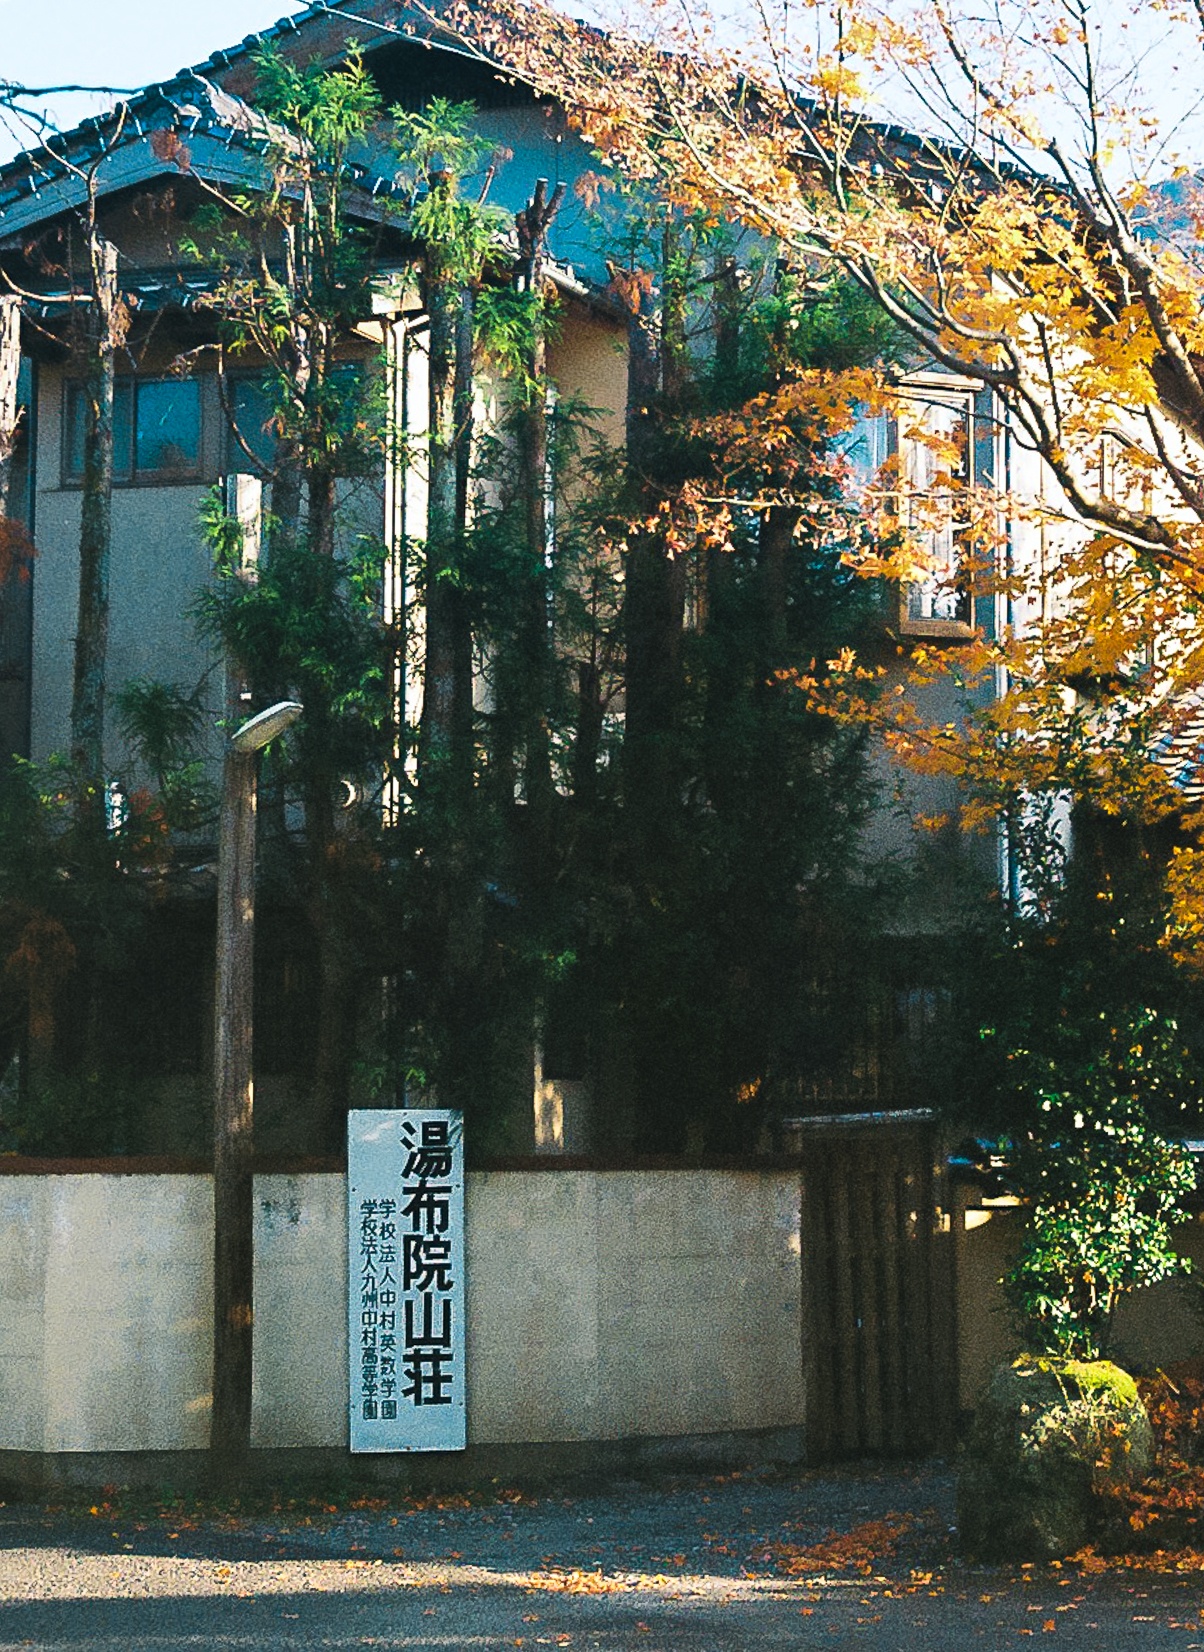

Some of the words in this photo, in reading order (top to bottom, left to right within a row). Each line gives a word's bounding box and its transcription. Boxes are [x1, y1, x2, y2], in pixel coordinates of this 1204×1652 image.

[378, 1199, 397, 1420] 学校法人中村英数学園
[401, 1120, 454, 1406] 湯布院山荘
